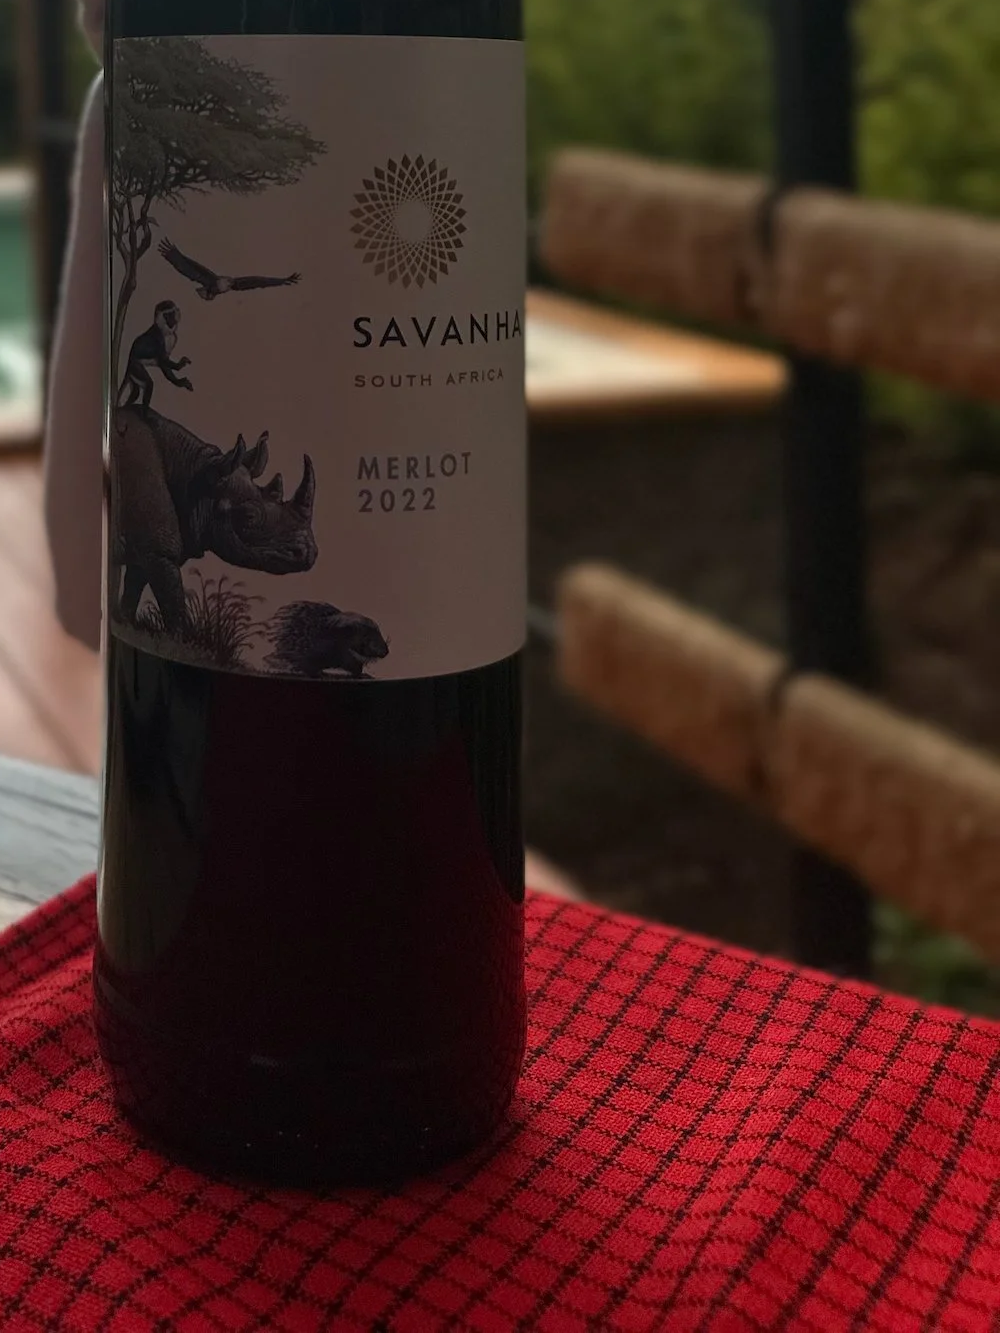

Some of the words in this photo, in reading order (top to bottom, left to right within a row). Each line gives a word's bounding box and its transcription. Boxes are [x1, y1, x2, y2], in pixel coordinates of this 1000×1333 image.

[353, 309, 522, 348] SAVANHA
[354, 374, 432, 388] SOUTH
[445, 367, 504, 385] AFRICA
[357, 452, 471, 480] MERLOT
[358, 487, 436, 513] 2022
